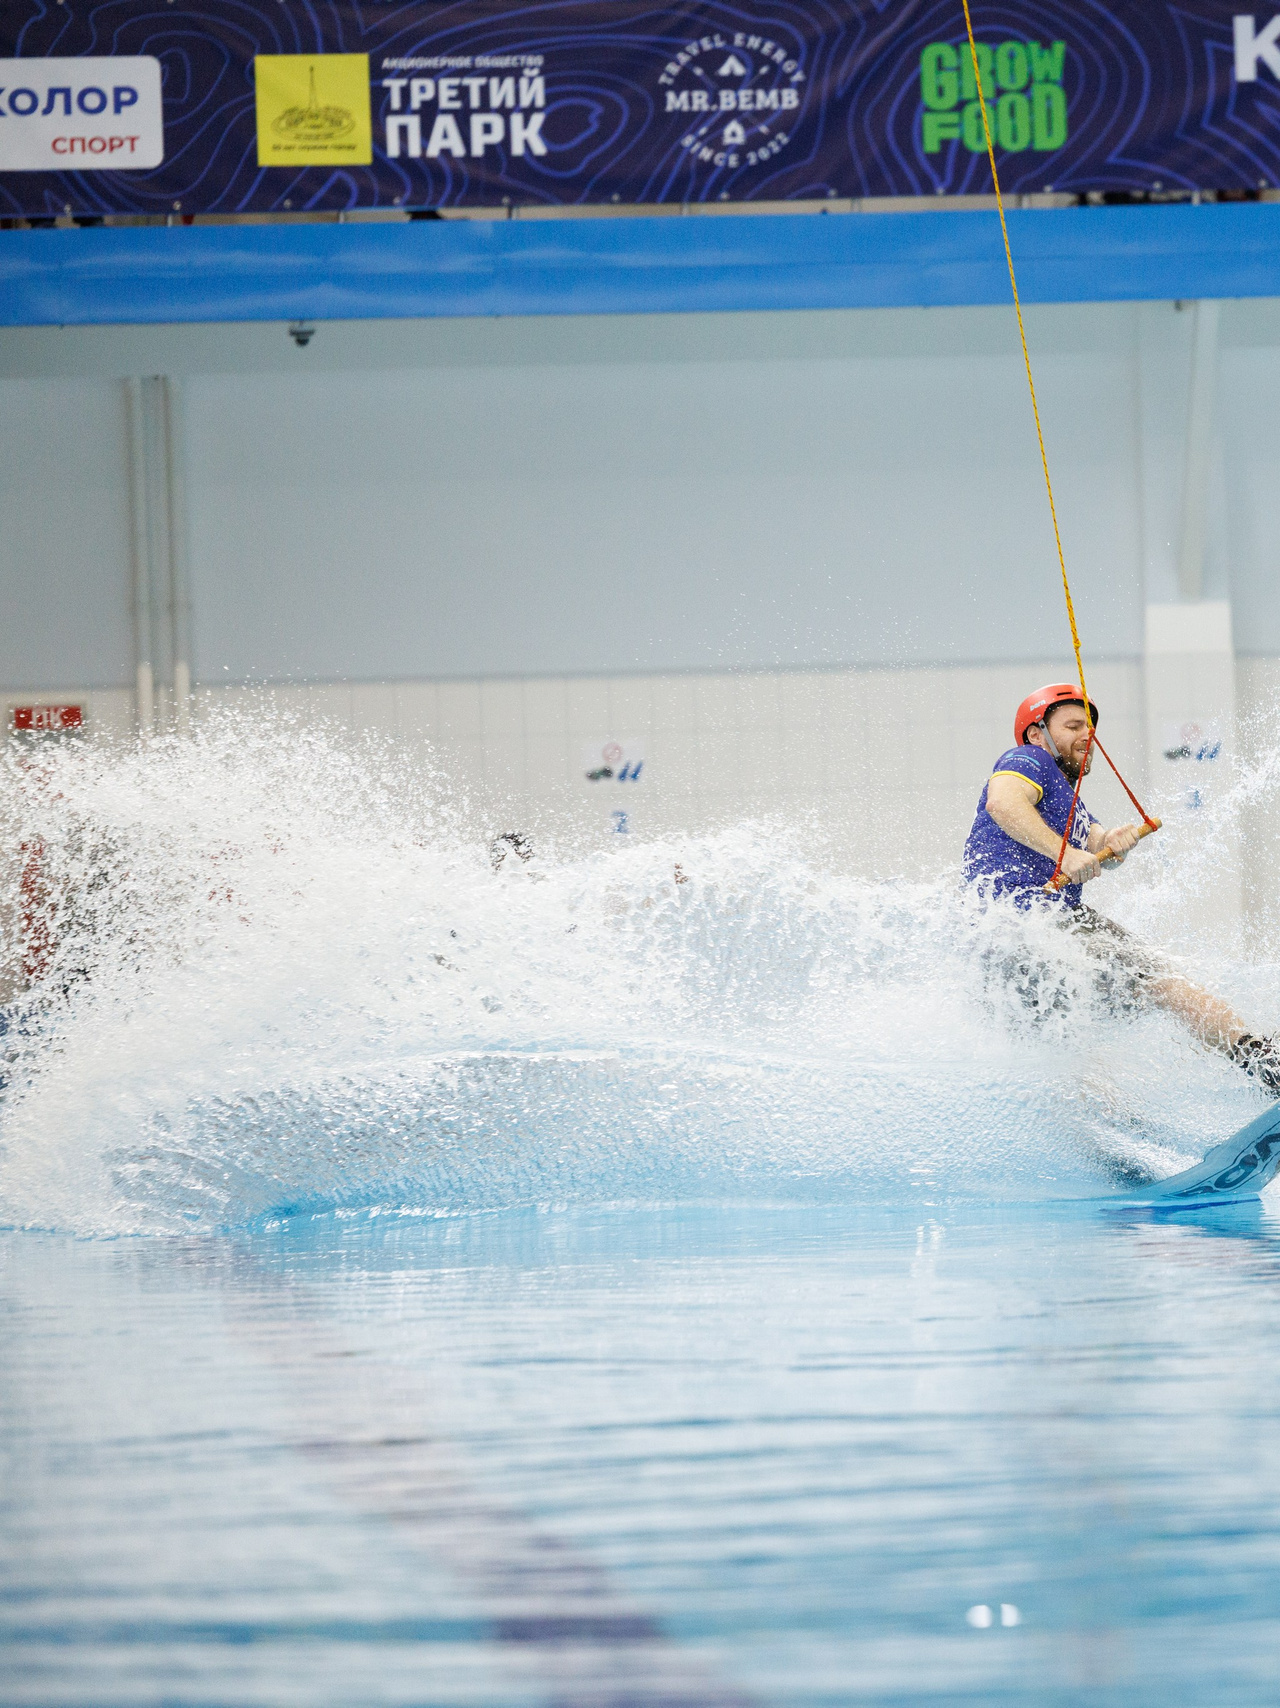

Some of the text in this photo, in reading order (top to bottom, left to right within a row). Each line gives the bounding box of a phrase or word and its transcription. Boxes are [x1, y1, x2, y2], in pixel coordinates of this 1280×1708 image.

[658, 32, 807, 86] TRAVEL ENERGY
[919, 40, 1067, 111] GROW
[0, 85, 139, 117] ОЛОР
[381, 67, 545, 111] ТРЕТИЙ
[665, 88, 799, 112] MR.BEMB
[385, 111, 548, 158] ПАРК
[922, 82, 1068, 154] FOOD
[51, 135, 140, 154] СПОРТ
[680, 134, 740, 169] SINCE
